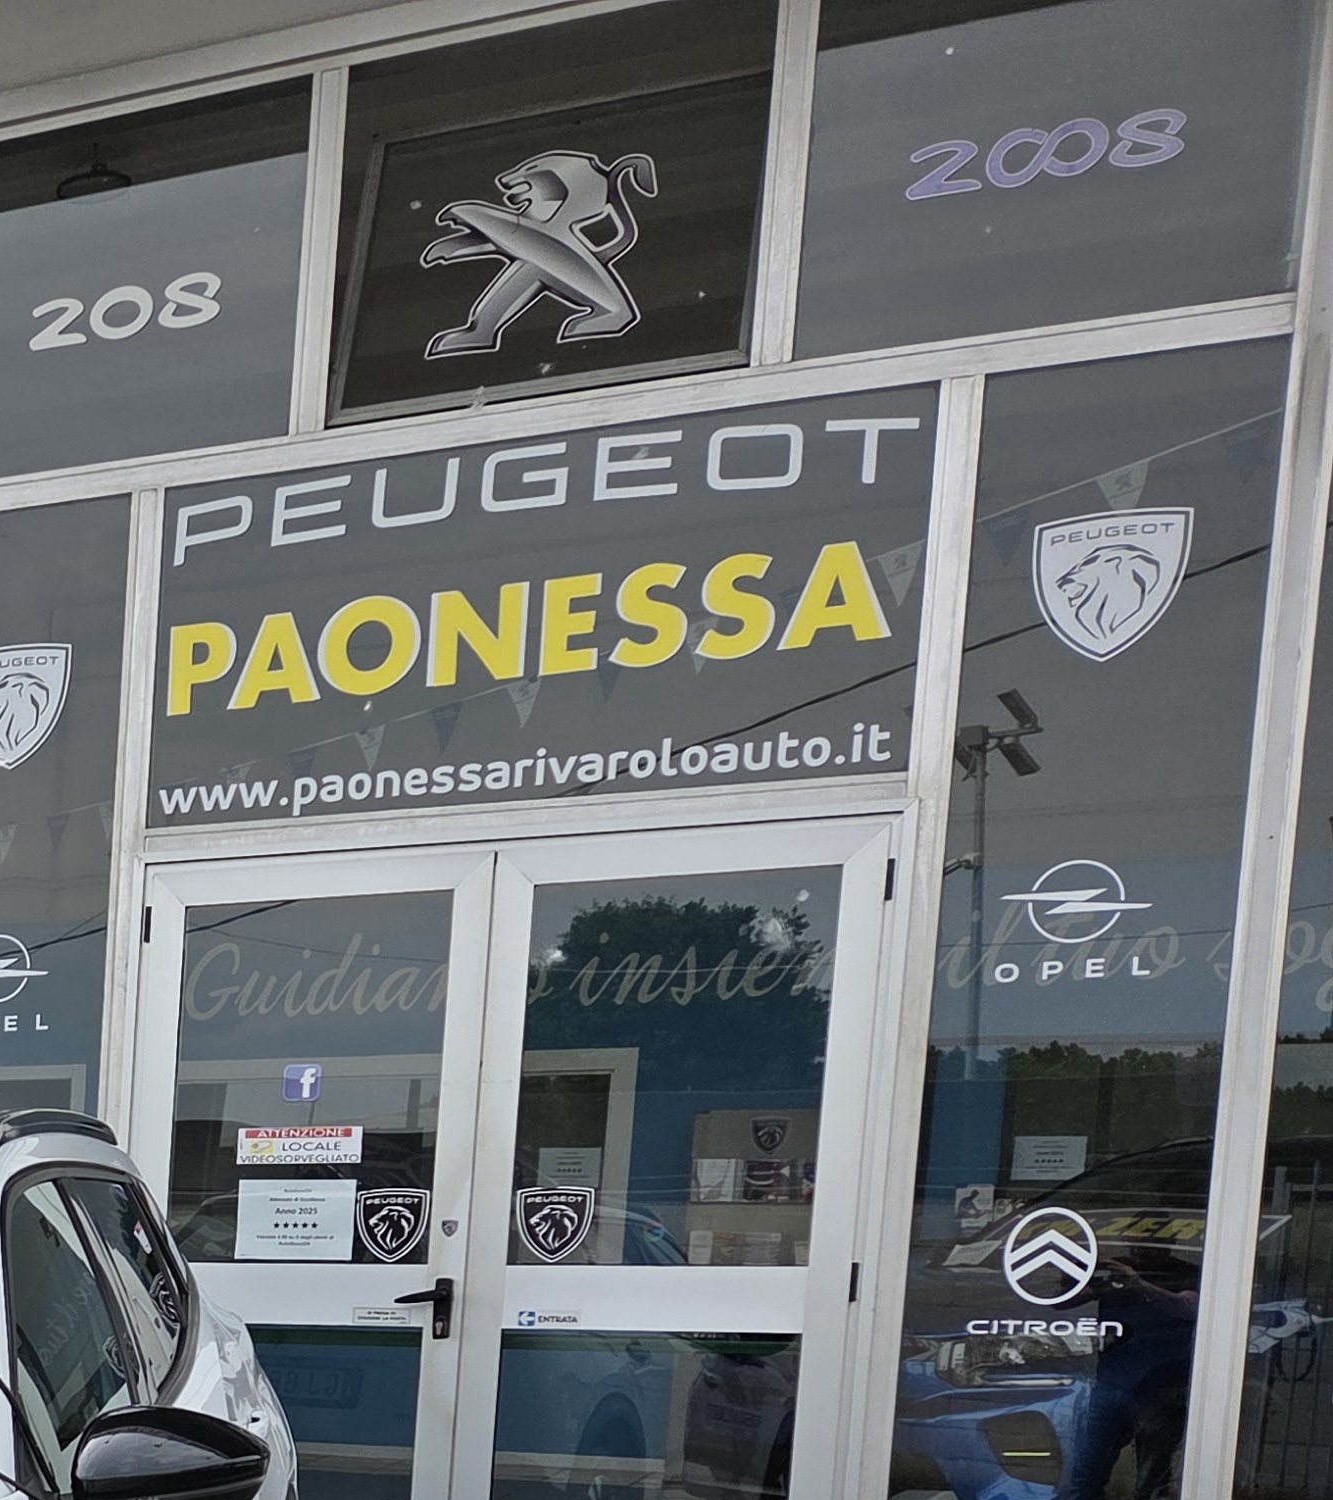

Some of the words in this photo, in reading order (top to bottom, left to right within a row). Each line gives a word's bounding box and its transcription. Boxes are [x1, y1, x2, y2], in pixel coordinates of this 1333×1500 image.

[905, 107, 1188, 201] 2008
[28, 272, 222, 351] 208
[173, 417, 920, 567] PEUGEOT
[1050, 521, 1176, 547] PEUGEOT
[167, 542, 891, 716] PAONESSA
[159, 722, 893, 817] www.paonessarivaroloauto.it
[994, 957, 1150, 982] OPEL
[258, 1128, 345, 1139] ATTENZIONE
[282, 1142, 341, 1152] LOCALE
[240, 1154, 359, 1165] VIDEOSORVEGLIATO
[366, 1197, 420, 1206] PEUGEOT
[526, 1196, 584, 1205] PEUGEOT
[1097, 1217, 1205, 1239] ZER
[538, 1315, 578, 1323] ENTRATA
